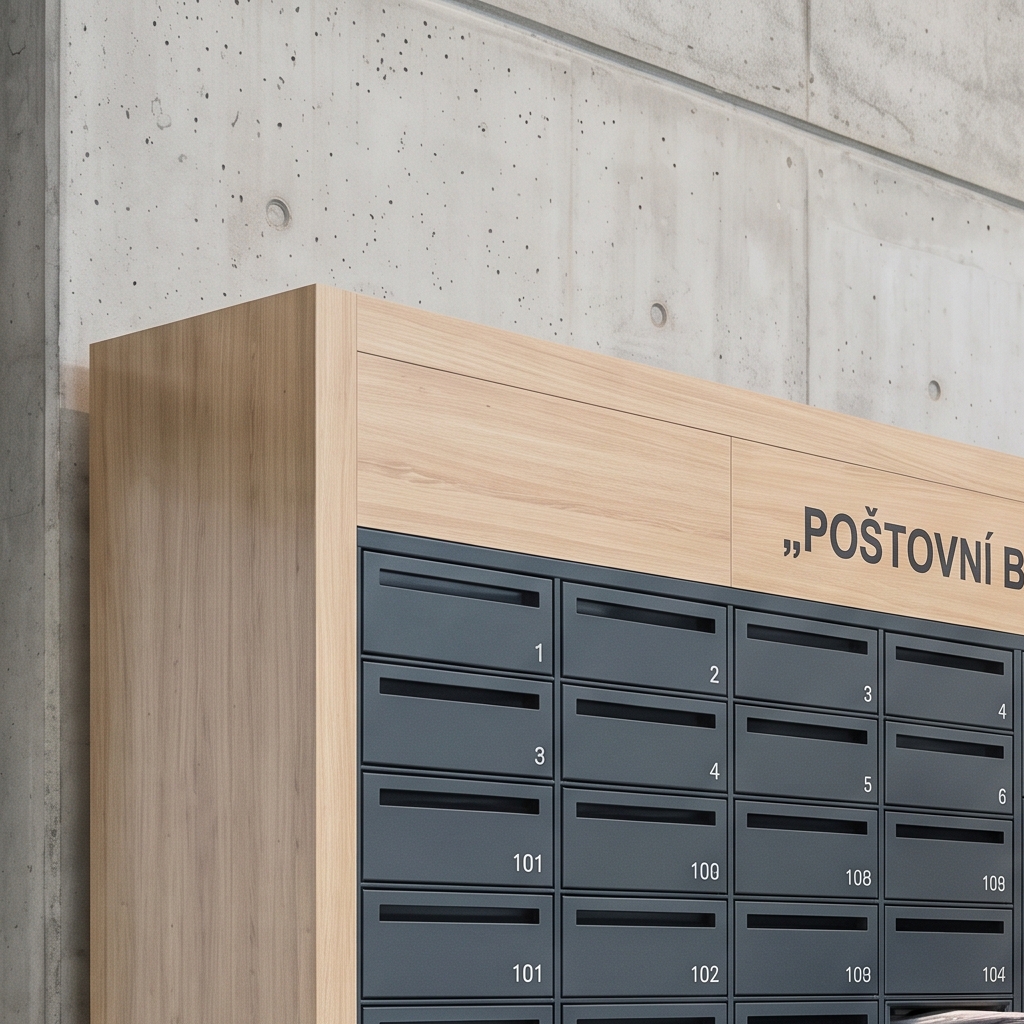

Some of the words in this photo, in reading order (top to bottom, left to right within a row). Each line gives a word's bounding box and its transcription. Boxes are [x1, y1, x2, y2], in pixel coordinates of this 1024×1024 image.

[534, 642, 543, 663] 1
[709, 665, 720, 684] 2
[863, 685, 873, 703] 3
[997, 703, 1008, 720] 4
[534, 746, 546, 766] 3
[709, 762, 721, 781] 4
[863, 775, 873, 793] 5
[998, 787, 1007, 805] 6
[513, 853, 542, 873] 101
[845, 868, 872, 887] 108
[512, 963, 542, 983] 101
[691, 964, 720, 983] 102
[982, 966, 1006, 983] 104
